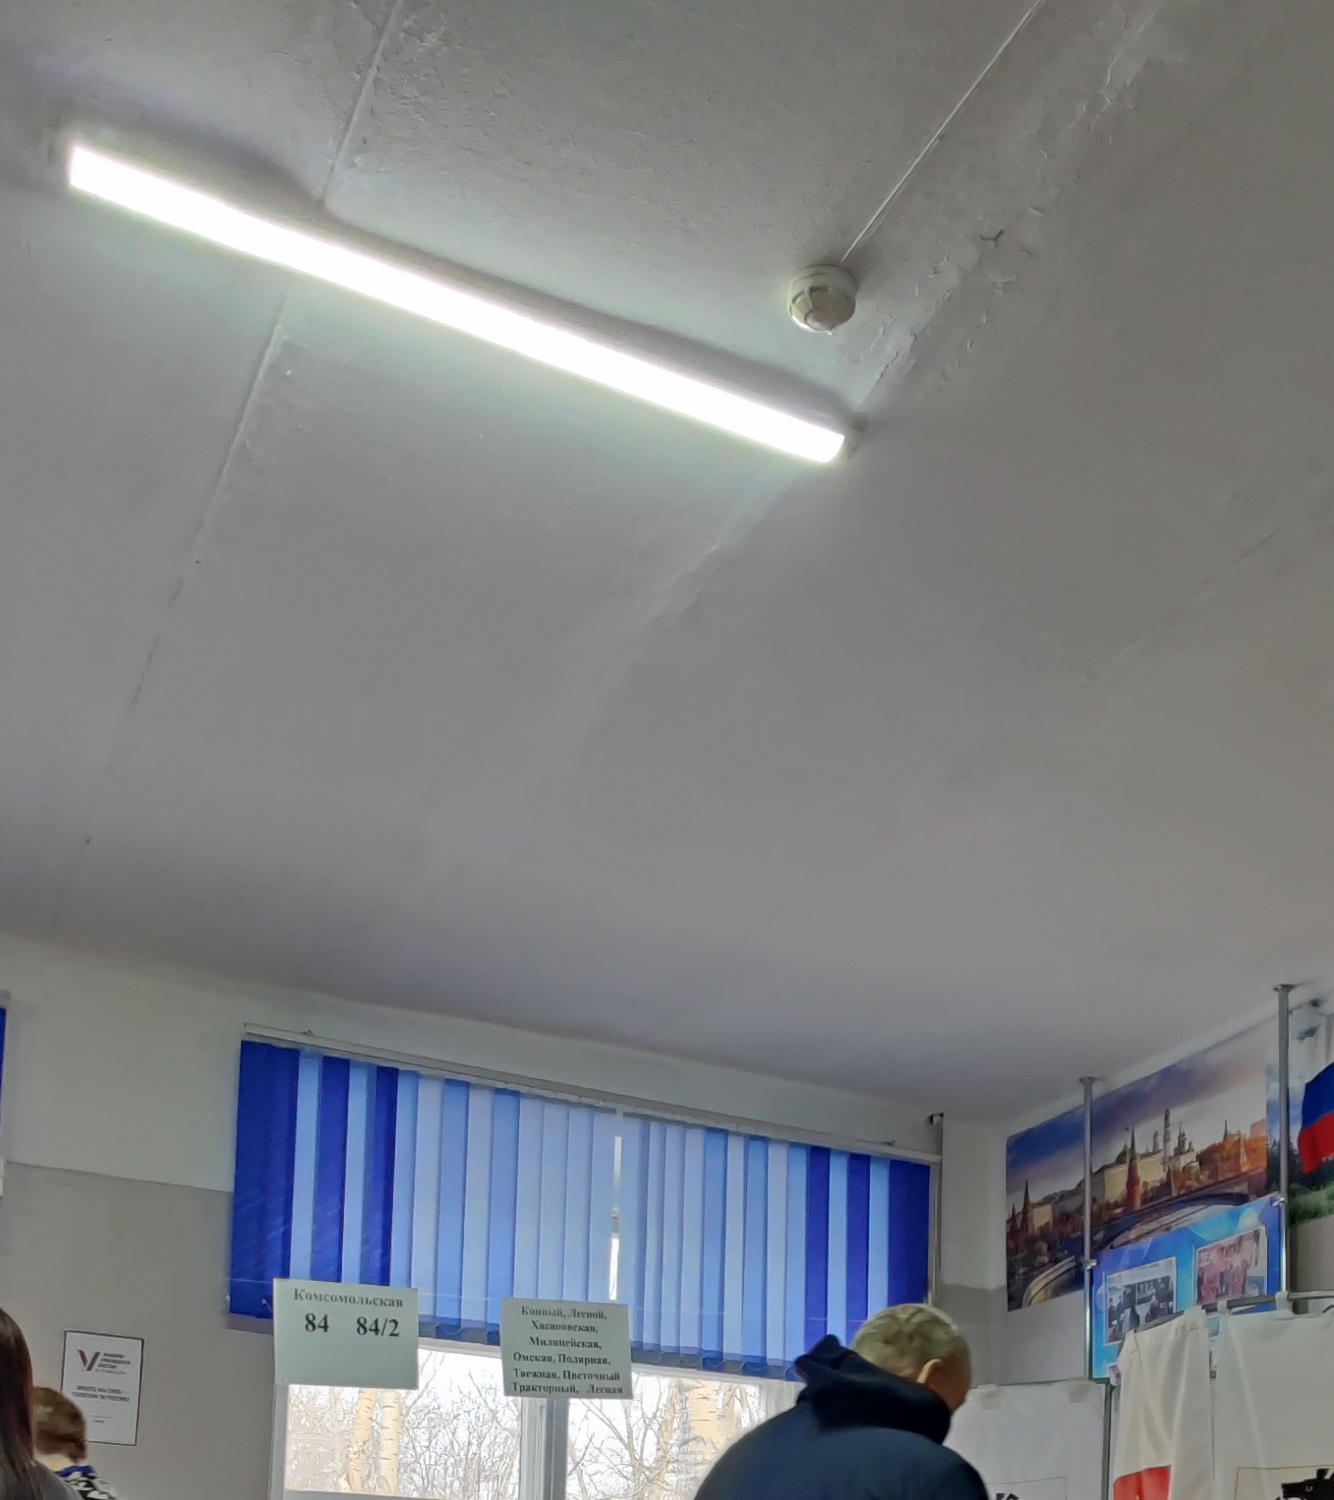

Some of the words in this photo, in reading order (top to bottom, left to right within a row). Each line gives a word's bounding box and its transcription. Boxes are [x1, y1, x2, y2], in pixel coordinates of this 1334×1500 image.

[294, 1288, 403, 1308] Комсомольская
[521, 1305, 567, 1319] Конный,
[568, 1308, 608, 1321] Лесной,
[304, 1312, 330, 1333] 84
[356, 1315, 401, 1338] 84/2
[529, 1336, 603, 1350] Милицейская,
[512, 1352, 556, 1365] Омская,
[512, 1381, 580, 1395] Тракторный,
[585, 1384, 624, 1395] Лесная
